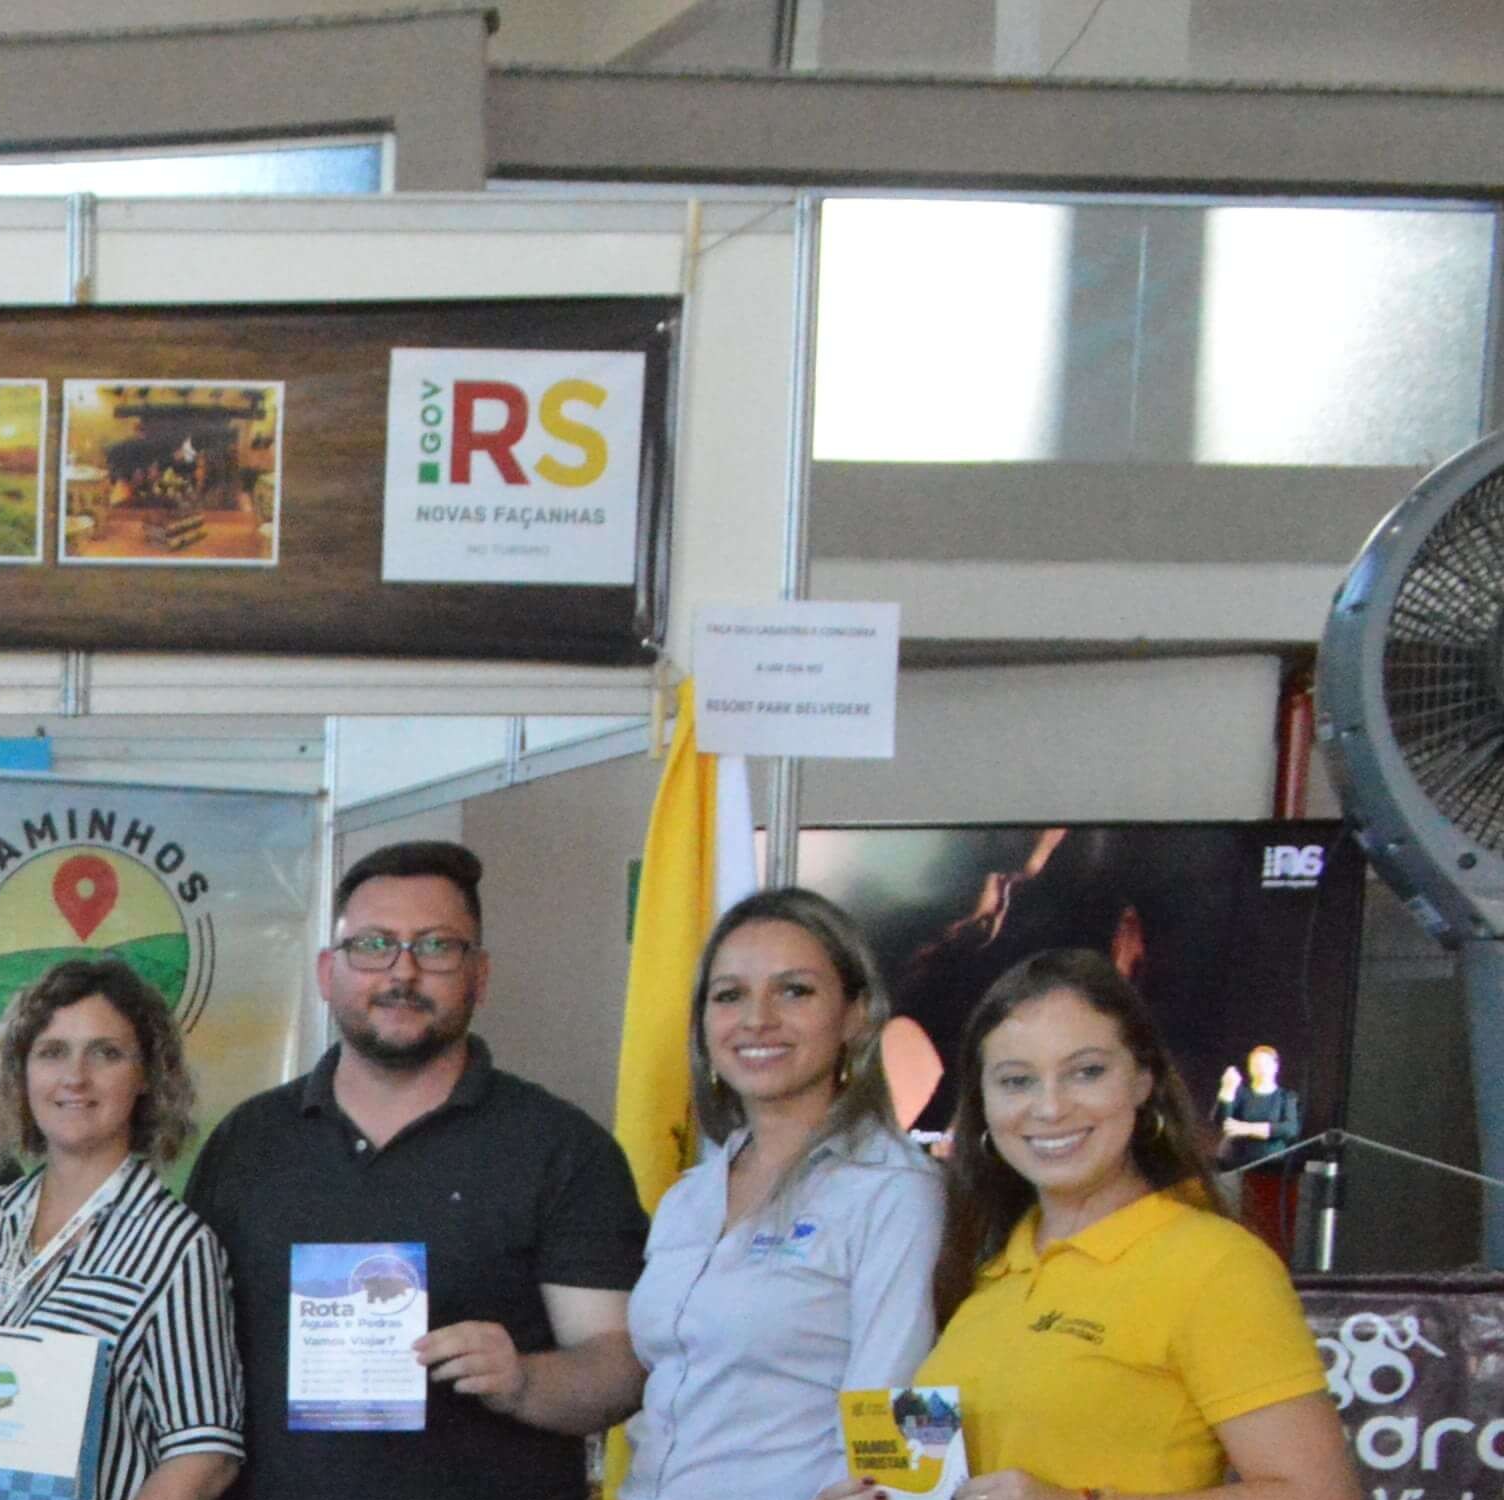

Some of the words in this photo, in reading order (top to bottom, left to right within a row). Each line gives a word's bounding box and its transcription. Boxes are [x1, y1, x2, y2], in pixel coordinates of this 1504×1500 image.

[421, 380, 443, 454] GOV
[449, 378, 609, 488] RS
[416, 504, 487, 523] NOVAS
[493, 505, 607, 531] FAÇANHAS
[300, 1300, 355, 1317] Rota
